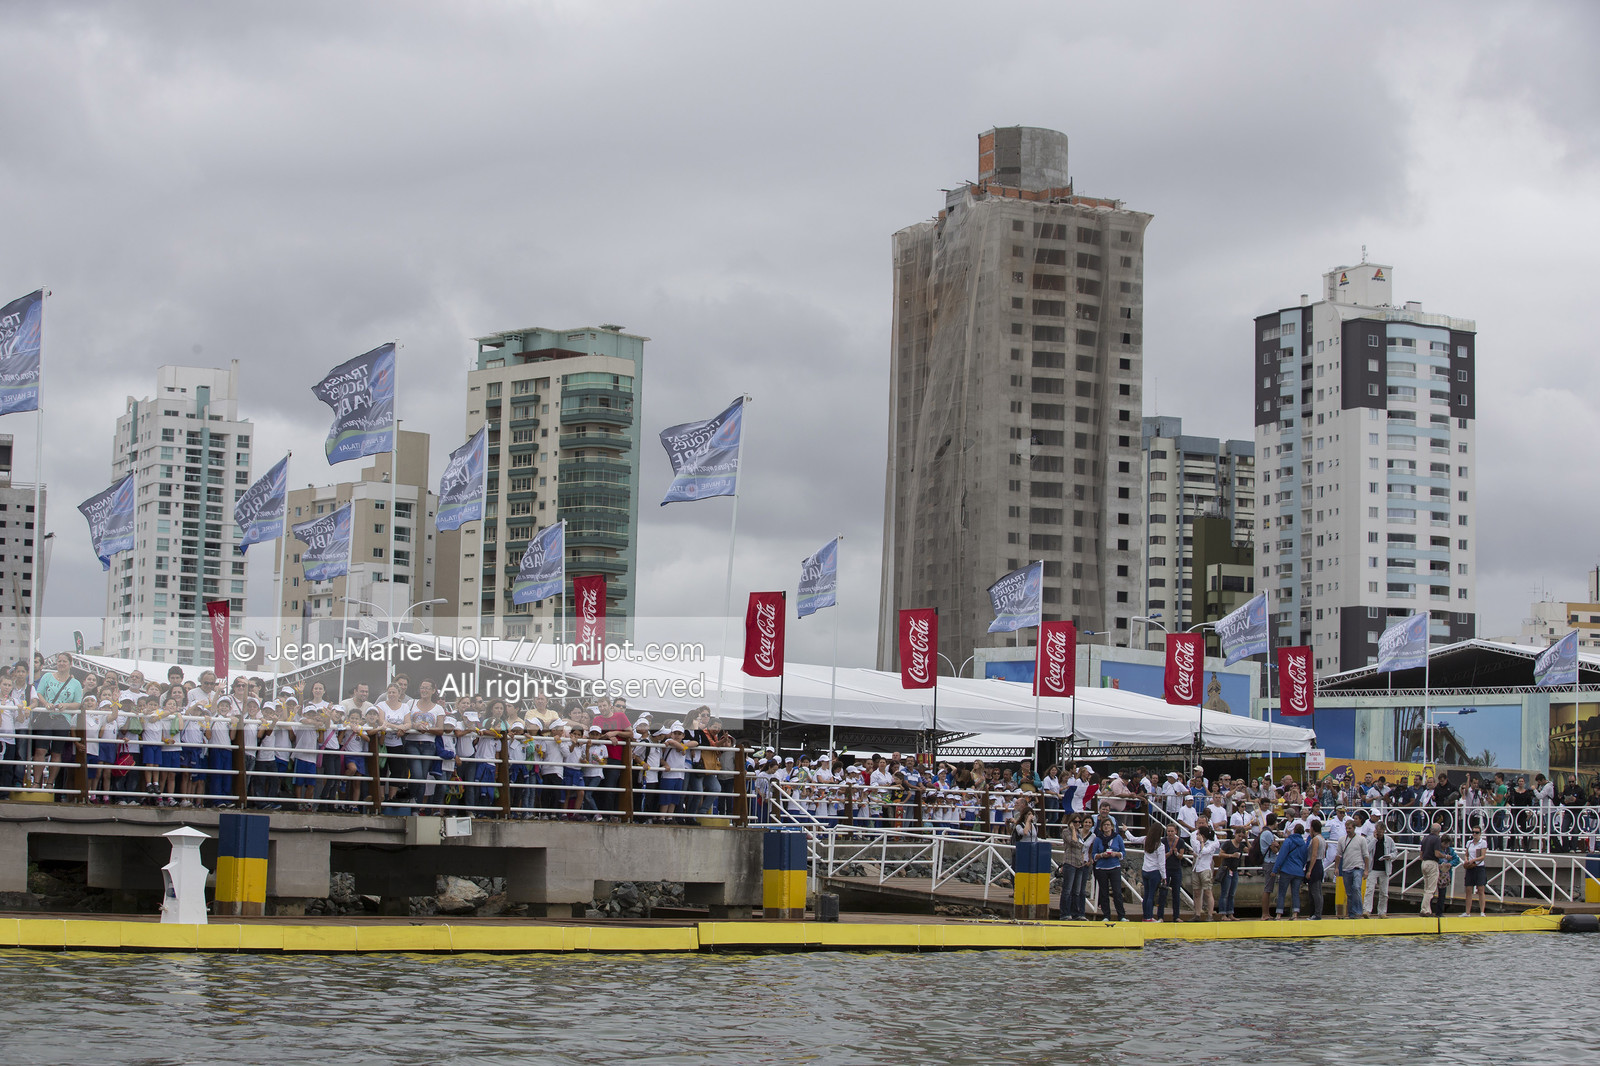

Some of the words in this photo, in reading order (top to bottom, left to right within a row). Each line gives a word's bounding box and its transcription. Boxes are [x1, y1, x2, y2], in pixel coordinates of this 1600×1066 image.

[755, 600, 776, 671] Coca-Cola
[908, 616, 930, 685] Coca-Cola
[1045, 629, 1067, 693] Coca-Cola
[1174, 640, 1196, 701] Coca-Cola
[1287, 653, 1308, 712] Coca-Cola
